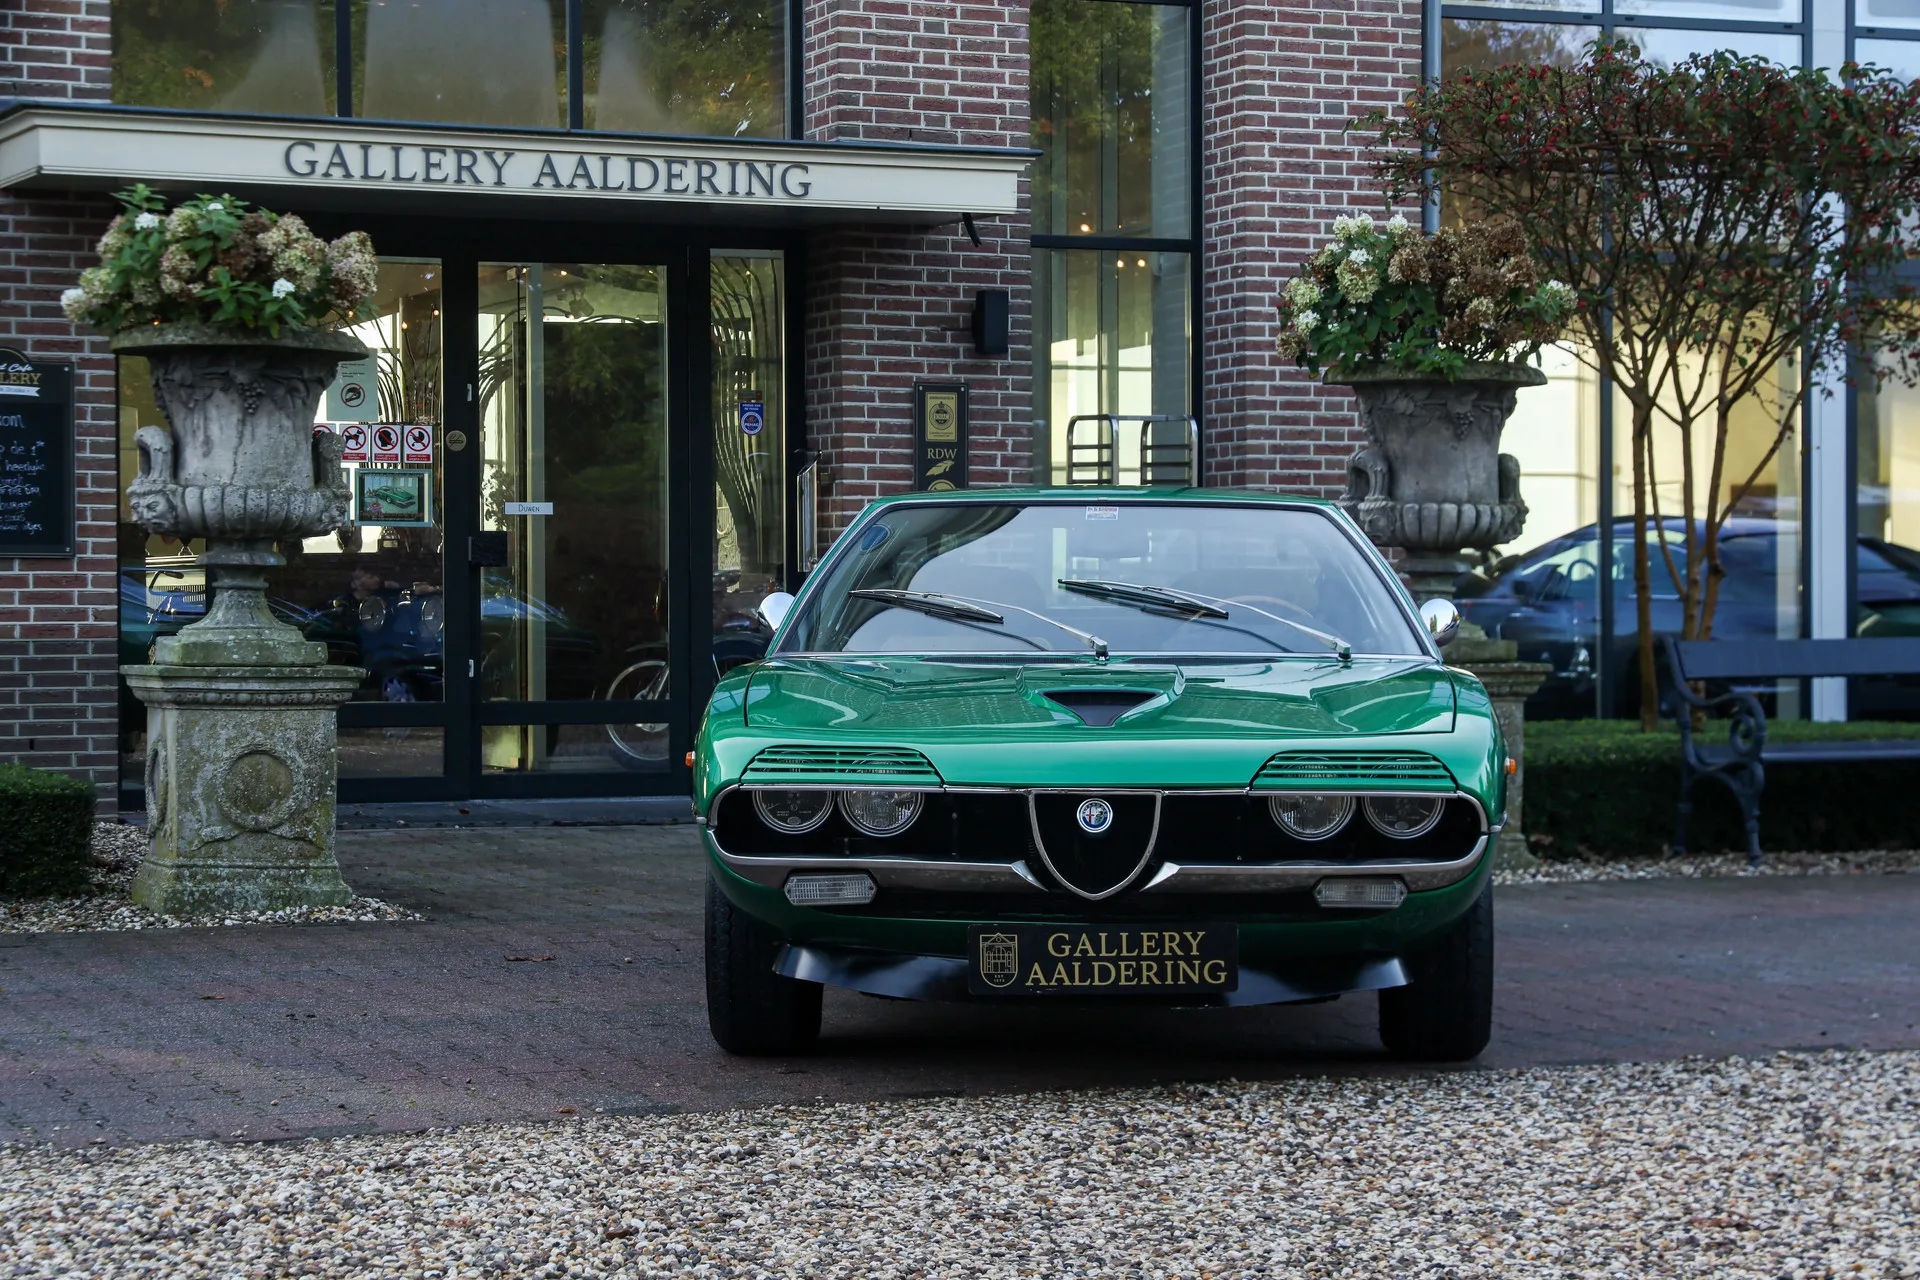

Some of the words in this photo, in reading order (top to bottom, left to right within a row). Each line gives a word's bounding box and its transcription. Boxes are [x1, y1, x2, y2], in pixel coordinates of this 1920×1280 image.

[284, 140, 514, 185] GALLERY
[533, 153, 812, 198] AALDERING
[927, 447, 957, 460] RDW
[1047, 932, 1206, 958] GALLERY
[1025, 960, 1228, 986] AALDERING
